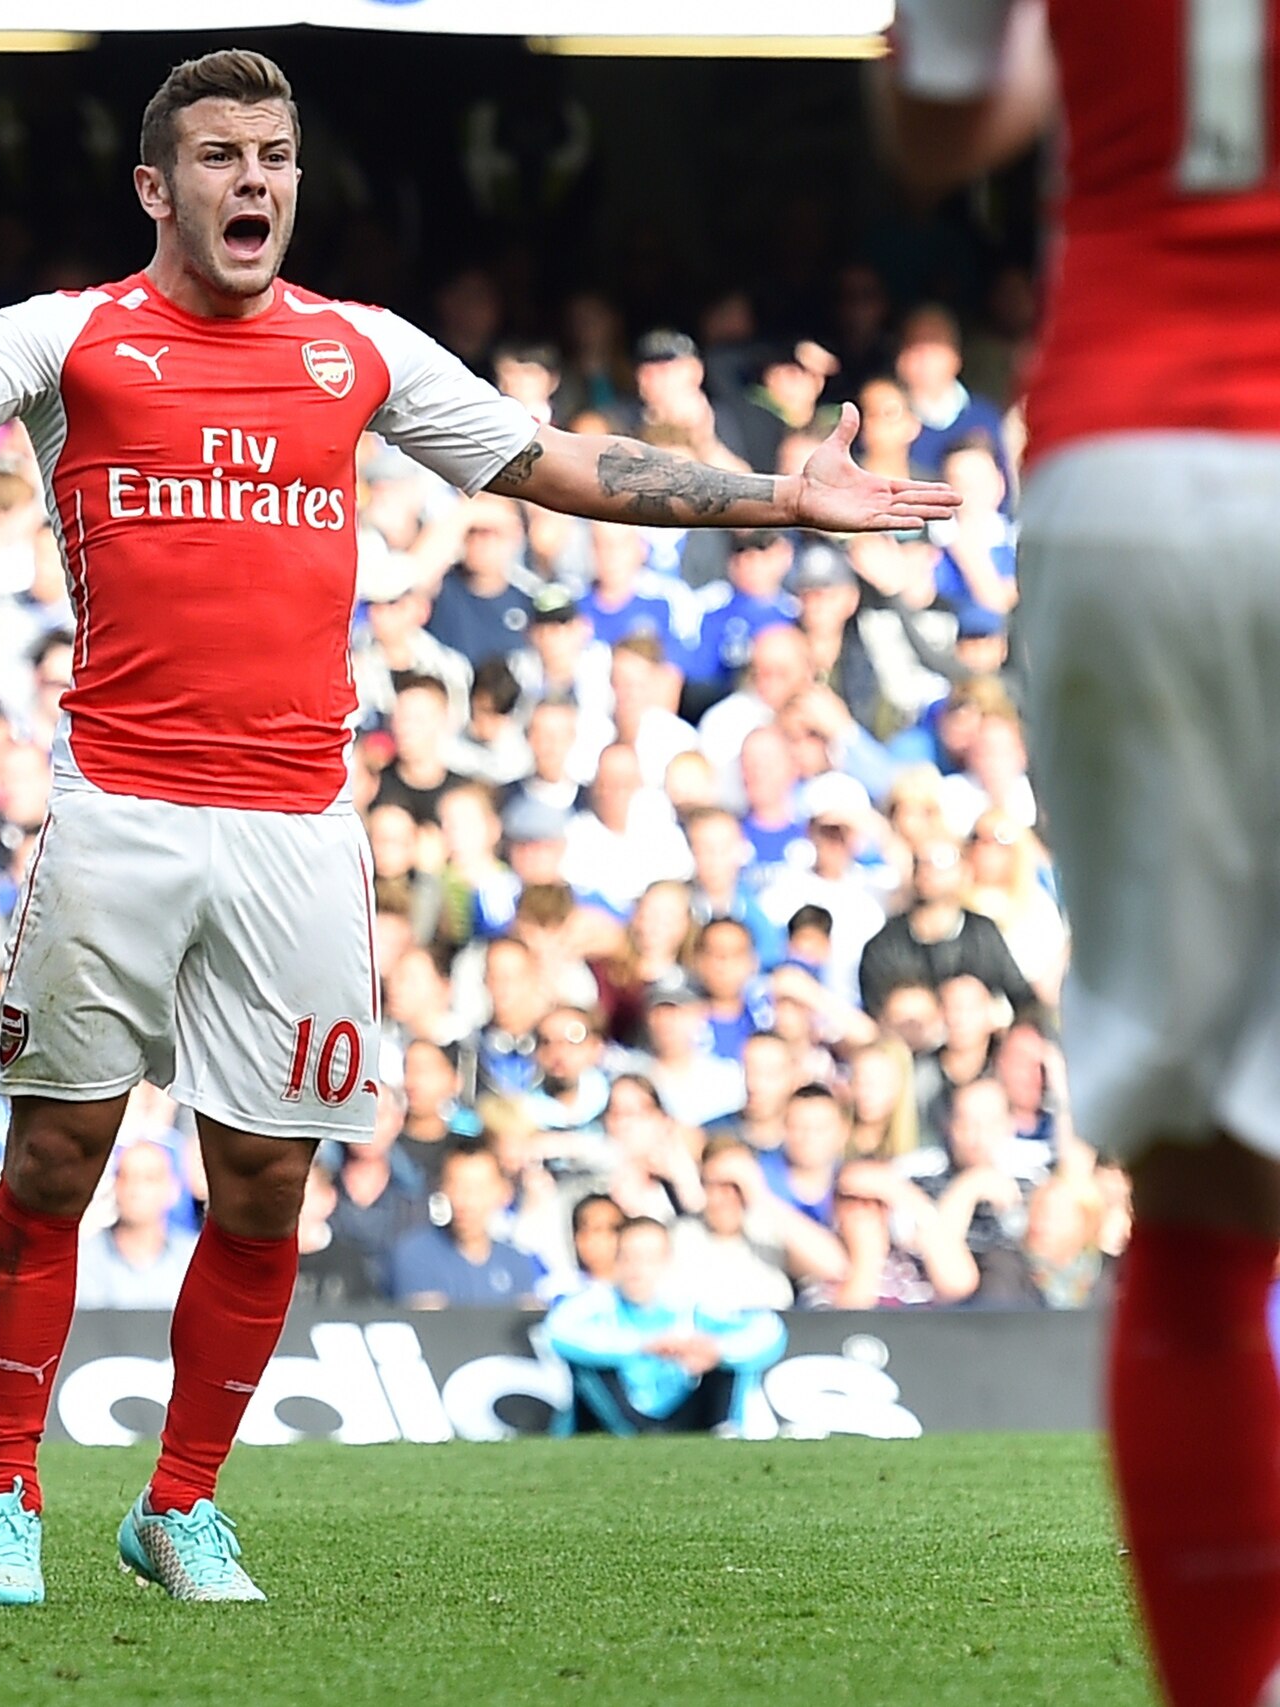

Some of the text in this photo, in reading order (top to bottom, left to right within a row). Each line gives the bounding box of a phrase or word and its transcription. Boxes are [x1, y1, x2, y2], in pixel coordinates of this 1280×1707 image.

[201, 427, 277, 473] Fly
[108, 467, 345, 531] Emirates
[281, 1013, 363, 1108] 10
[58, 1322, 922, 1445] adids
